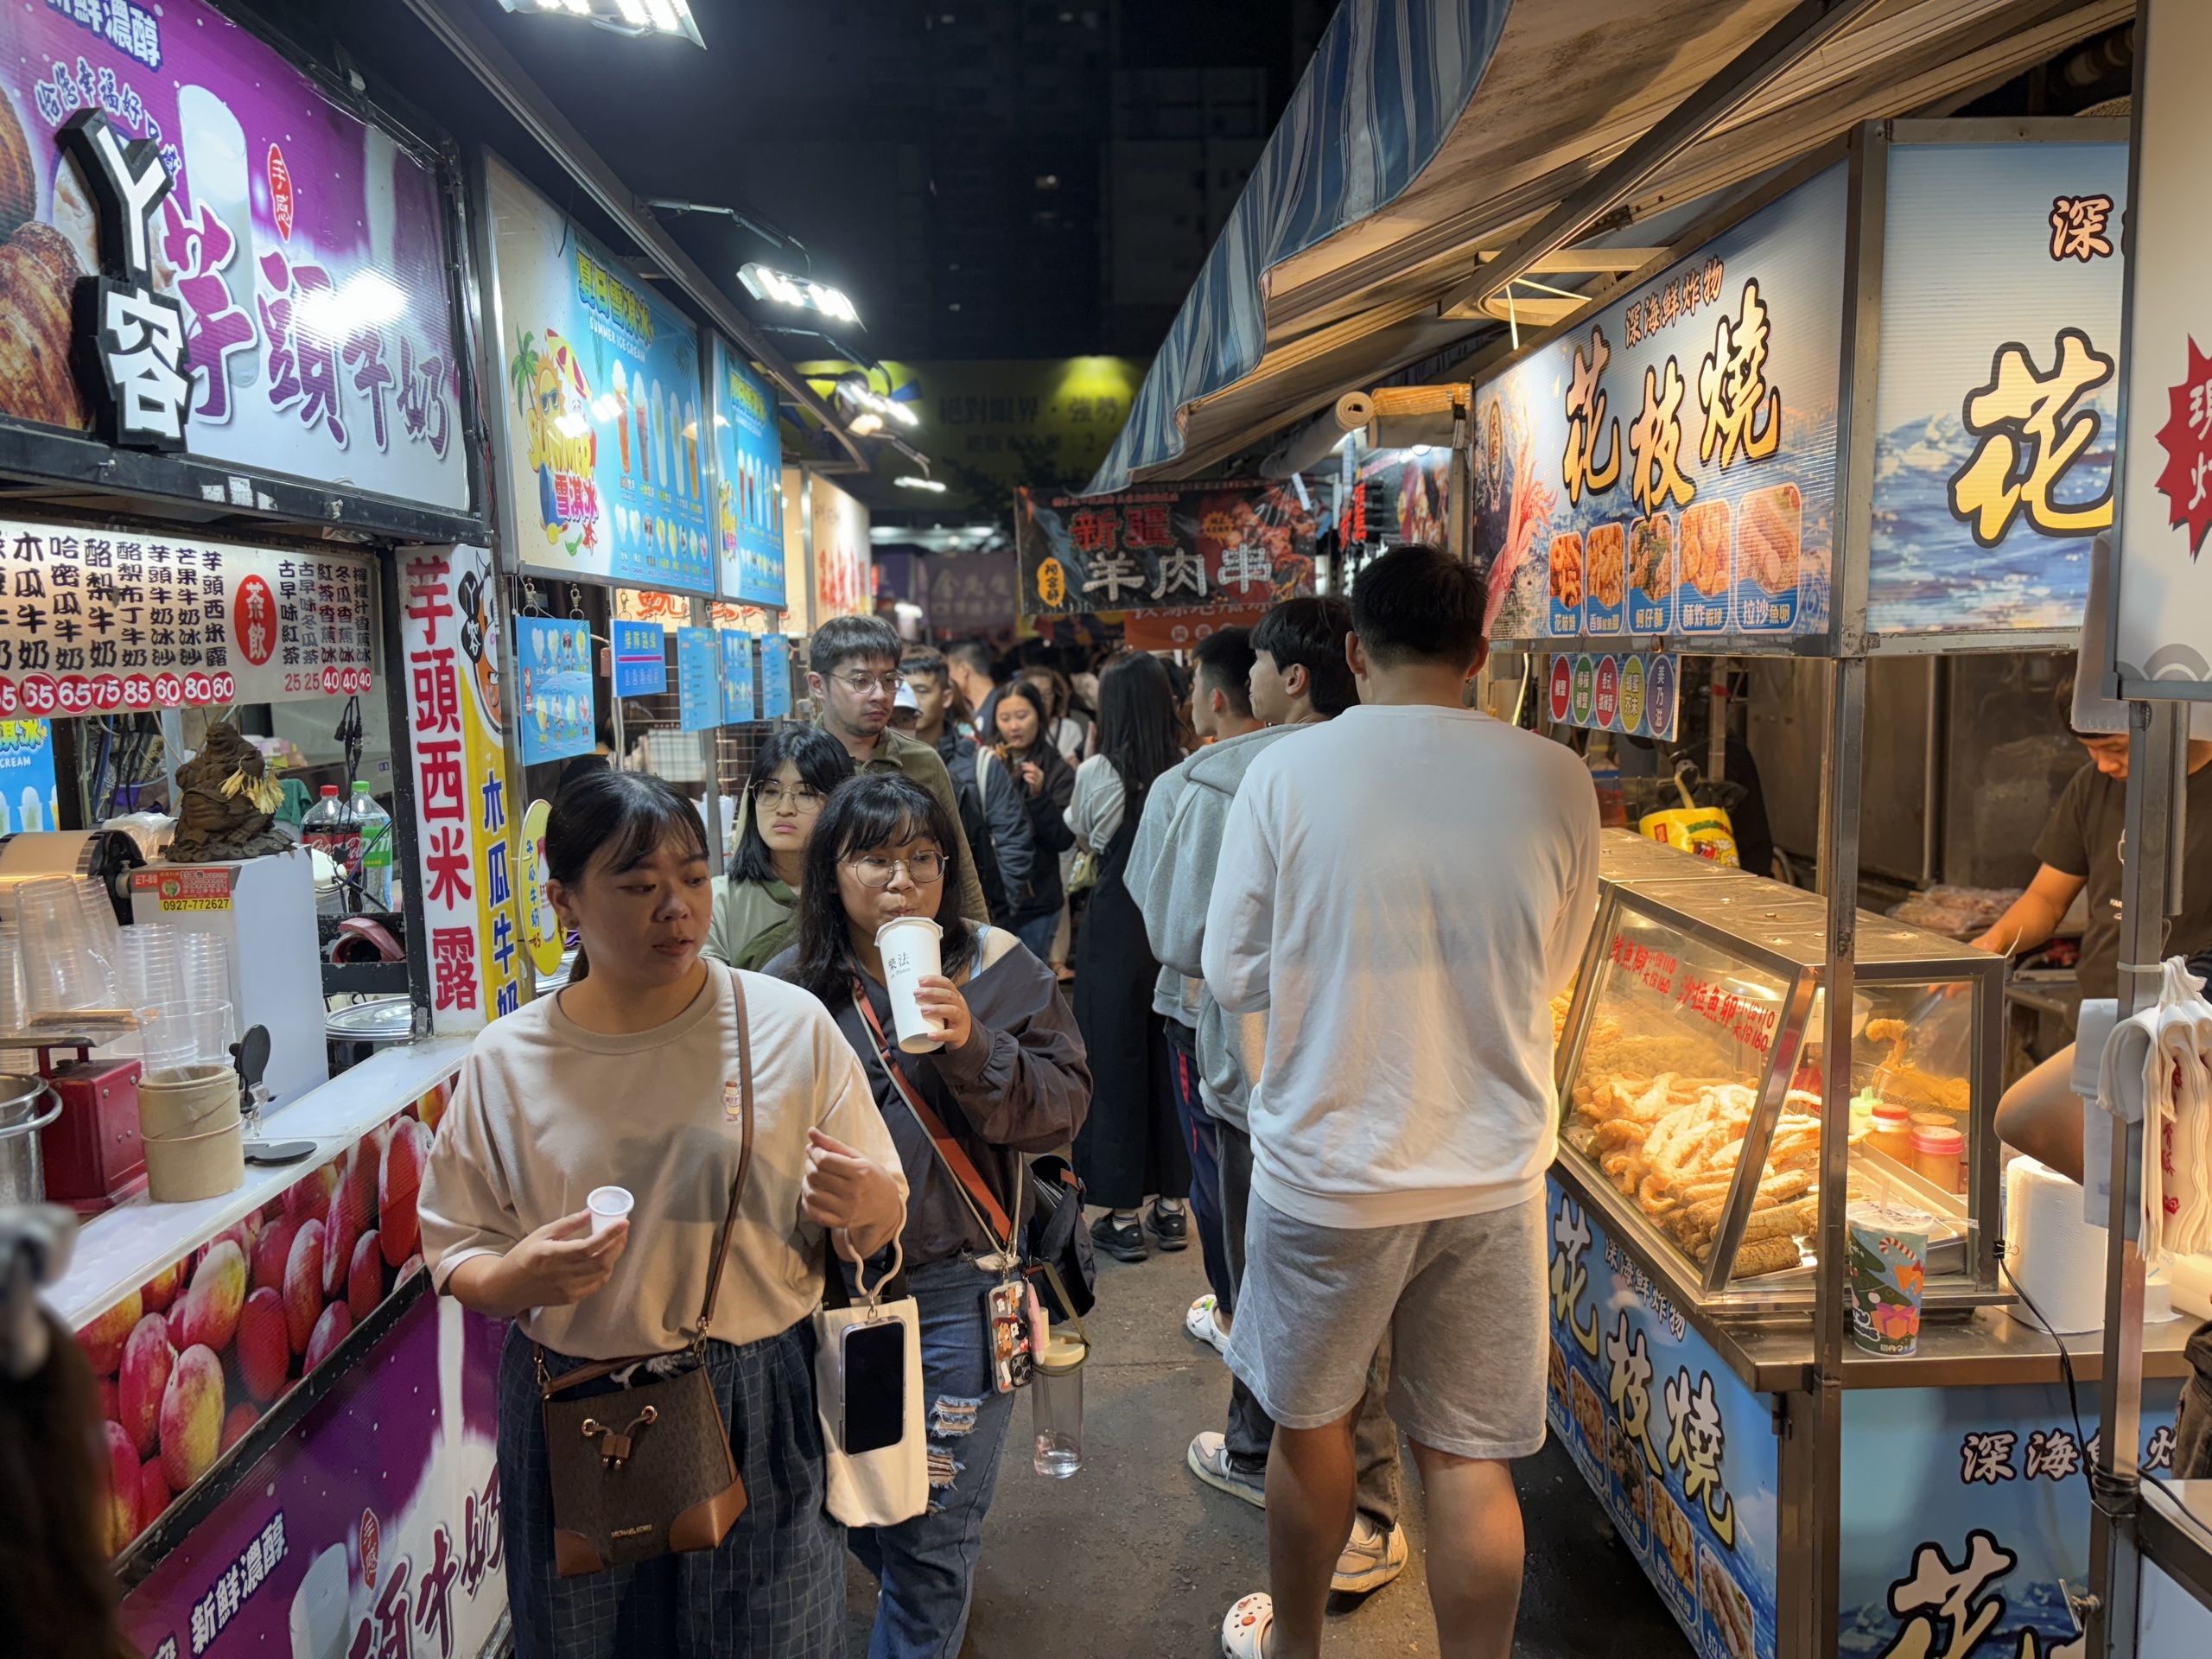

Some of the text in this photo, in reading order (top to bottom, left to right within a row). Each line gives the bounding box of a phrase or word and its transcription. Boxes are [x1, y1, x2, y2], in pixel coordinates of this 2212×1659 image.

[1624, 254, 1725, 349] 深海鮮炸物
[1562, 278, 1782, 517] 花枝燒
[1070, 505, 1177, 552] 新疆
[13, 531, 50, 671] 木瓜牛奶
[48, 535, 85, 671] 哈密瓜牛奶
[84, 537, 118, 669] 酪梨牛奶
[116, 541, 147, 668] 酪梨布丁牛奶
[147, 544, 176, 667] 芋頭牛奶冰沙
[175, 547, 203, 667] 芒果牛奶冰沙
[1082, 543, 1272, 602] 羊肉串
[201, 550, 228, 668] 芋頭西米露
[245, 581, 268, 660] 茶飲
[278, 559, 300, 665] 古早味紅茶
[298, 561, 320, 665] 古早味冬瓜茶
[317, 563, 338, 664] 紅茶香蕉冰
[335, 565, 355, 664] 冬瓜香蕉冰
[26, 682, 54, 709] 65
[58, 681, 92, 707] 65
[92, 679, 120, 710] 75
[123, 680, 152, 704] 85
[155, 679, 181, 707] 60
[184, 677, 212, 701] 80
[214, 676, 235, 698] 60
[284, 673, 302, 692] 25
[303, 672, 321, 691] 25
[322, 671, 340, 690] 40
[342, 671, 358, 690] 40
[358, 671, 372, 688] 40
[0, 755, 32, 769] CREAM
[405, 556, 479, 1012] 芋頭西米露
[135, 874, 158, 886] ET-89
[163, 899, 230, 911] 0927-772627
[480, 770, 518, 1018] 木瓜牛奶
[1676, 974, 1739, 1029] 沙拉魚卵
[1732, 1018, 1770, 1053] 大份160
[1605, 1236, 1687, 1343] 深海鮮炸物
[1550, 1192, 1736, 1552] 花枝燒
[190, 1512, 289, 1655] 新鮮濃醇
